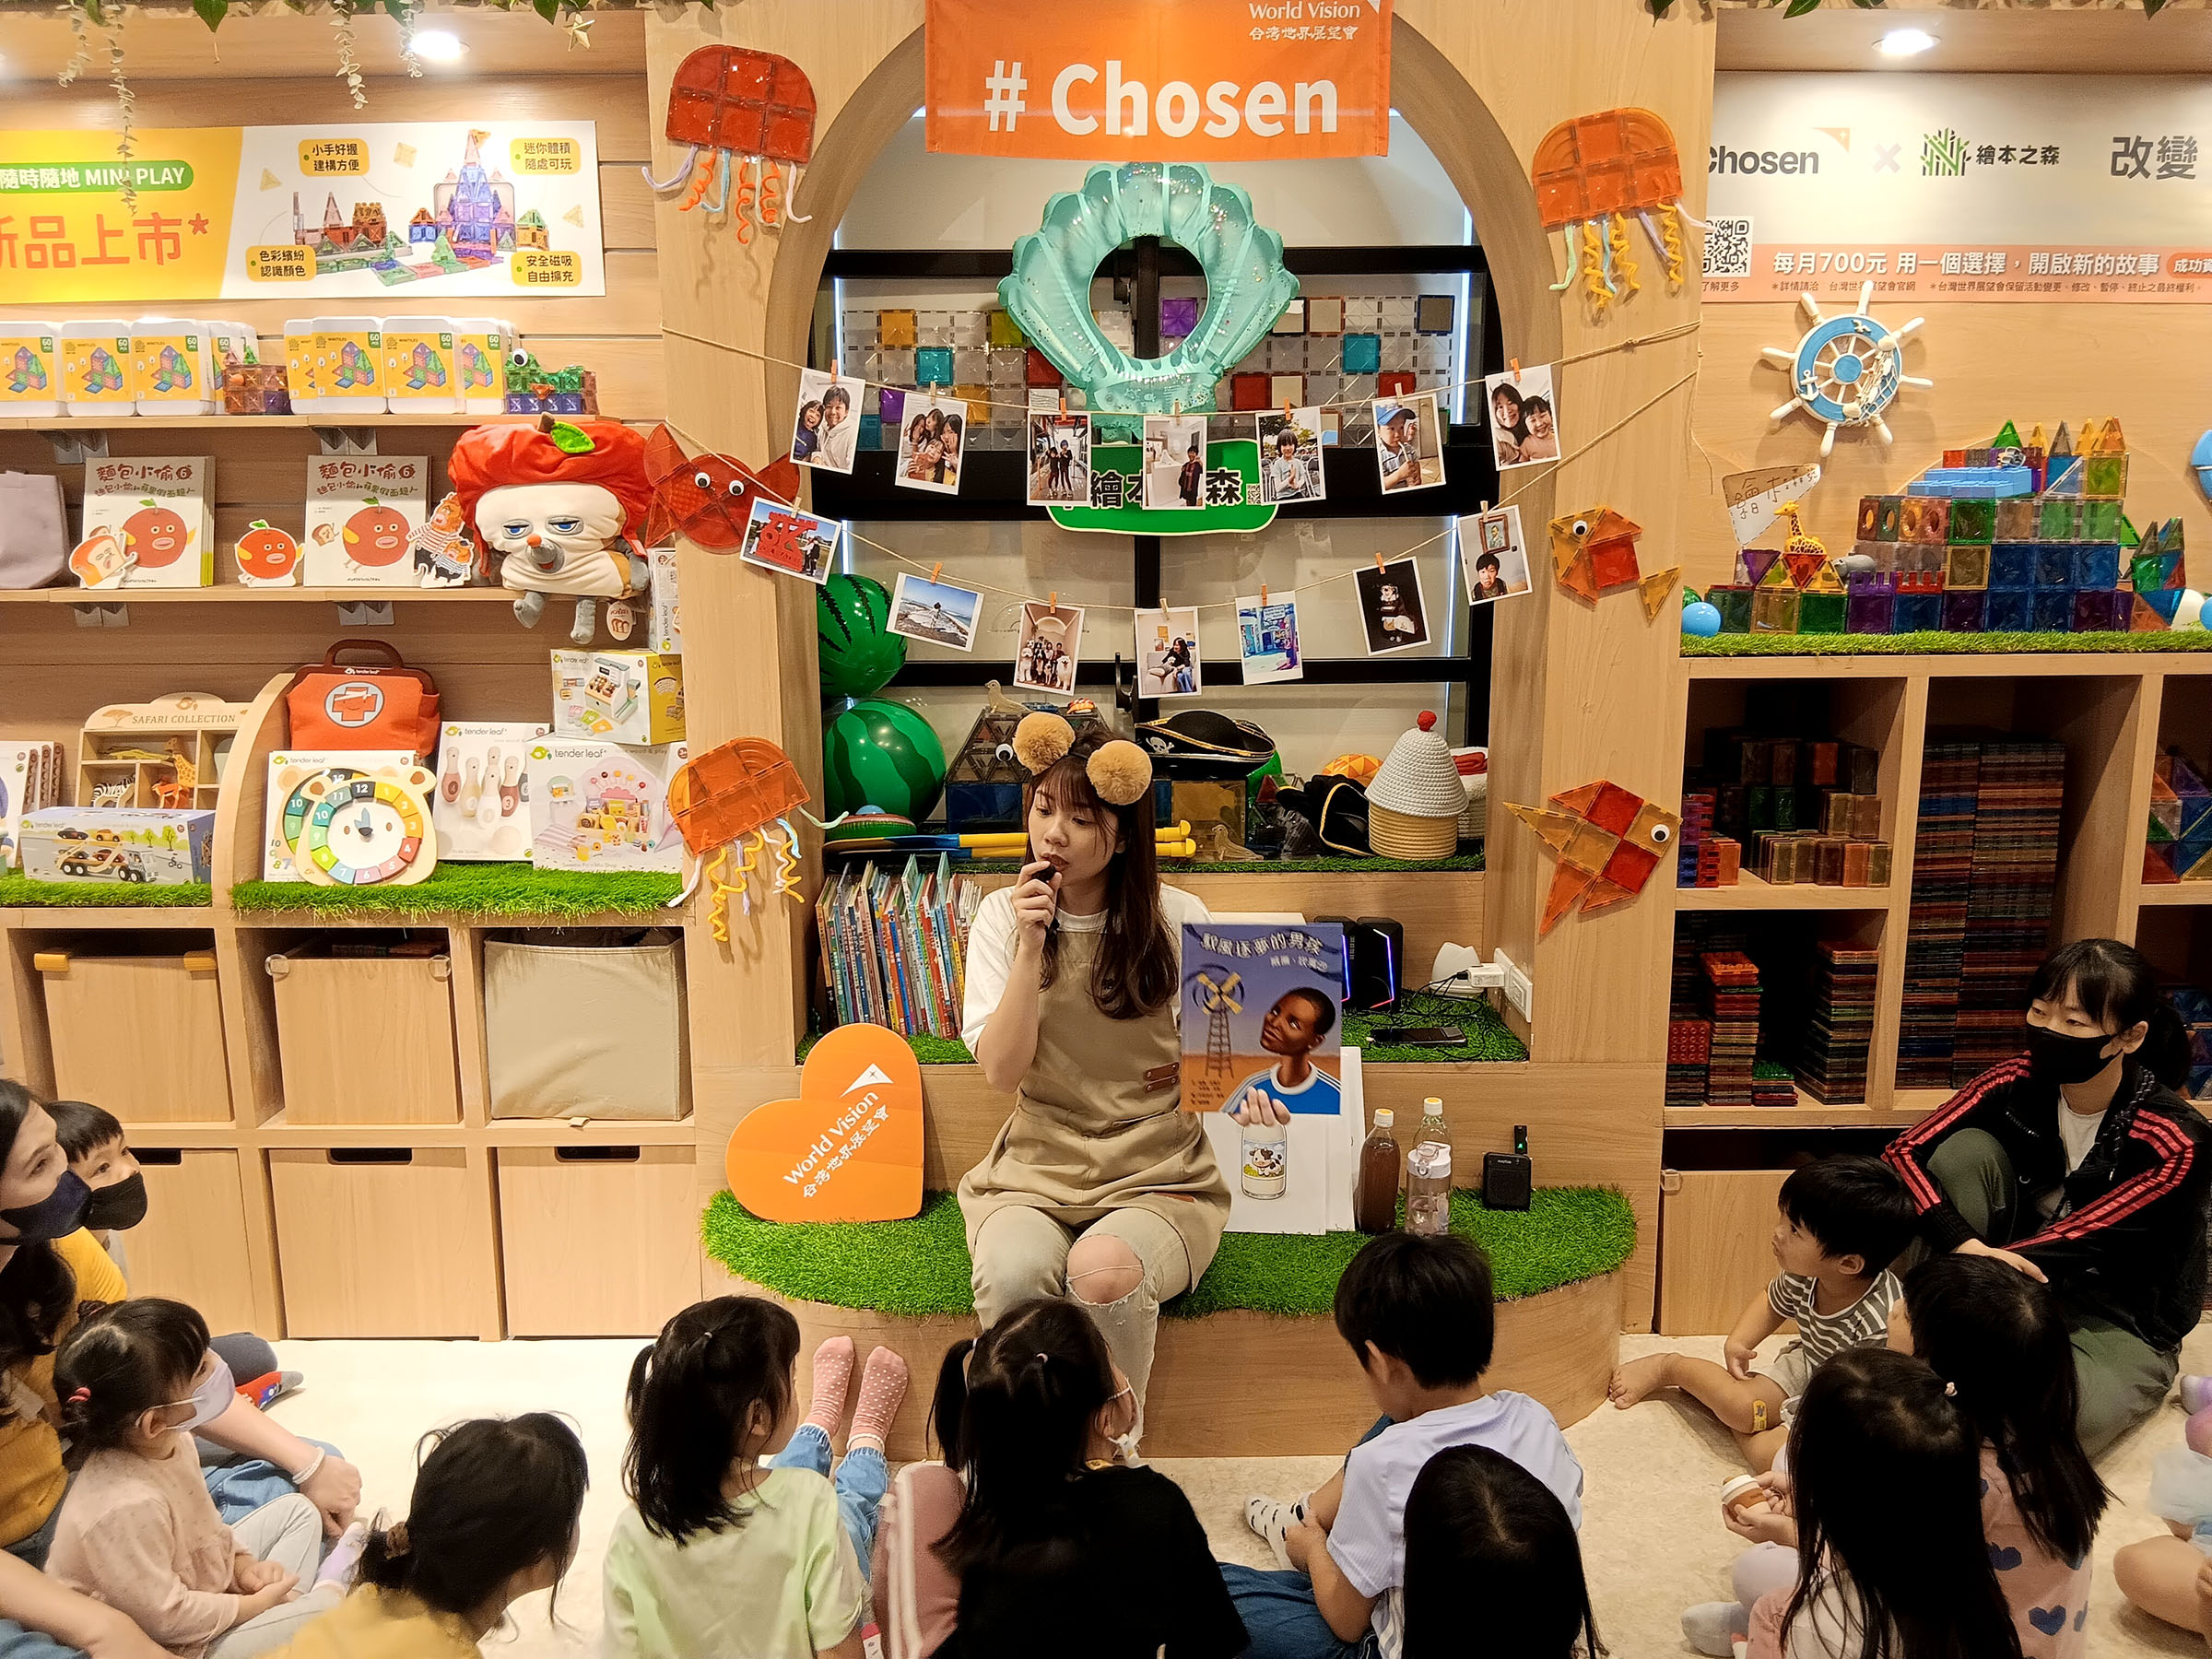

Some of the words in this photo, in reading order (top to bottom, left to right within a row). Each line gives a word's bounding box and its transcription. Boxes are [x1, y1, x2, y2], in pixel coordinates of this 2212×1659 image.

[1249, 1, 1302, 20] World
[1308, 1, 1361, 19] Vision
[1051, 60, 1338, 138] Chosen
[312, 143, 359, 157] 小手好握
[524, 142, 571, 156] 迷你體積
[1976, 145, 2061, 166] 繪本之森
[2110, 135, 2197, 180] 改變
[313, 159, 359, 173] 建構方便
[524, 158, 572, 171] 隨處可玩
[0, 167, 80, 190] 隨時隨地
[136, 167, 185, 185] PLAY
[259, 250, 305, 263] 色彩繽紛
[526, 254, 573, 267] 安全磁吸
[1773, 252, 1888, 276] 每月700元
[260, 265, 306, 277] 認識顏色
[527, 270, 574, 283] 自由擴充
[41, 338, 52, 347] 60
[441, 335, 452, 343] 60
[488, 335, 499, 343] 60
[1090, 467, 1243, 508] 繪森
[133, 715, 168, 724] SAFARI
[171, 714, 236, 724] COLLECTION
[465, 726, 487, 736] tender
[488, 726, 505, 736] leaf
[555, 747, 584, 759] tender
[585, 747, 602, 759] leaf
[355, 784, 369, 794] 12
[333, 791, 344, 800] 11
[290, 799, 303, 808] 10
[402, 801, 408, 810] 2
[505, 799, 511, 808] 3
[315, 811, 329, 820] 10
[313, 832, 321, 841] 9
[271, 839, 281, 847] 10
[404, 844, 411, 853] 4
[282, 858, 291, 870] 7
[389, 862, 395, 871] 5
[339, 868, 347, 877] 7
[363, 870, 371, 879] 6
[782, 1134, 834, 1185] World
[829, 1091, 879, 1137] Vision
